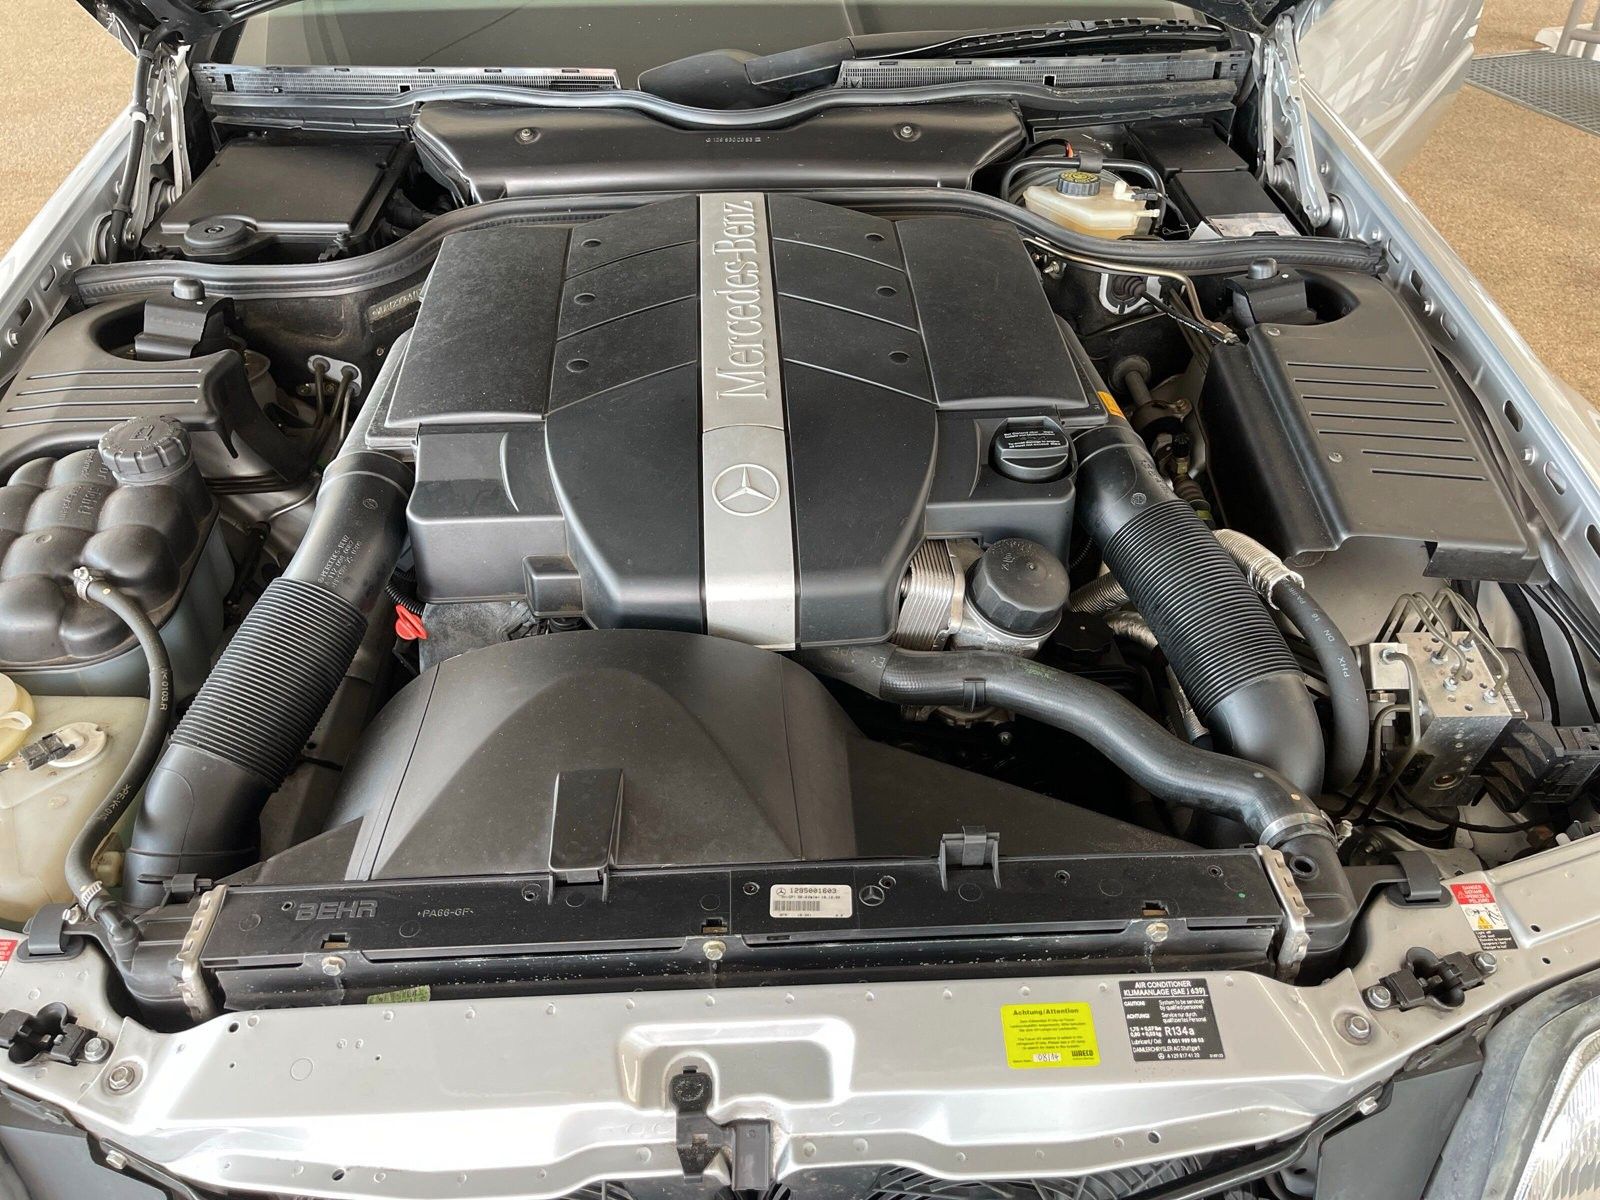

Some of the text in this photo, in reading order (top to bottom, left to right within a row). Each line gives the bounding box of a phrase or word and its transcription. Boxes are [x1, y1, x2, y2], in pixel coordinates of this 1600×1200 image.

[712, 200, 768, 400] Mercedes-Benz
[1324, 630, 1335, 642] DN
[295, 900, 378, 920] BEHR
